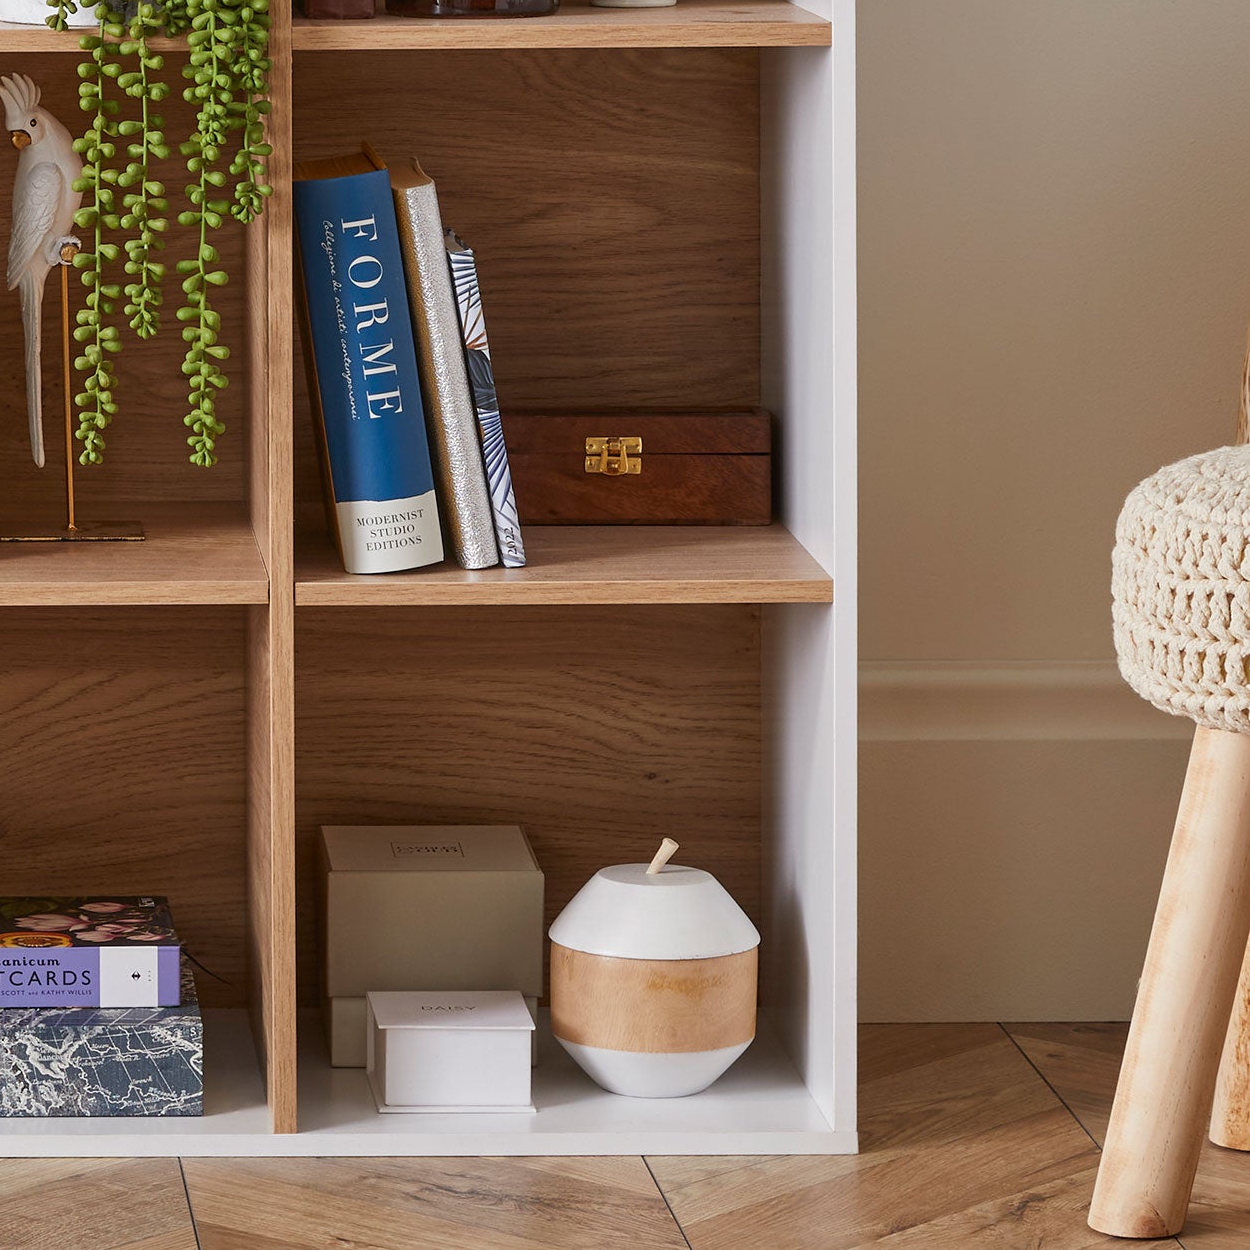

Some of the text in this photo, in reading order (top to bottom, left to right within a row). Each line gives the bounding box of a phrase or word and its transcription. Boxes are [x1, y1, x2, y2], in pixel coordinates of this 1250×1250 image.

[332, 278, 343, 292] di
[334, 296, 348, 335] artisti
[340, 213, 403, 419] FORME
[340, 338, 361, 421] contemporanei
[356, 508, 424, 527] MODERNIST
[369, 523, 415, 538] STUDIO
[365, 535, 423, 552] EDITIONS
[503, 526, 518, 555] 2022
[27, 989, 39, 997] and
